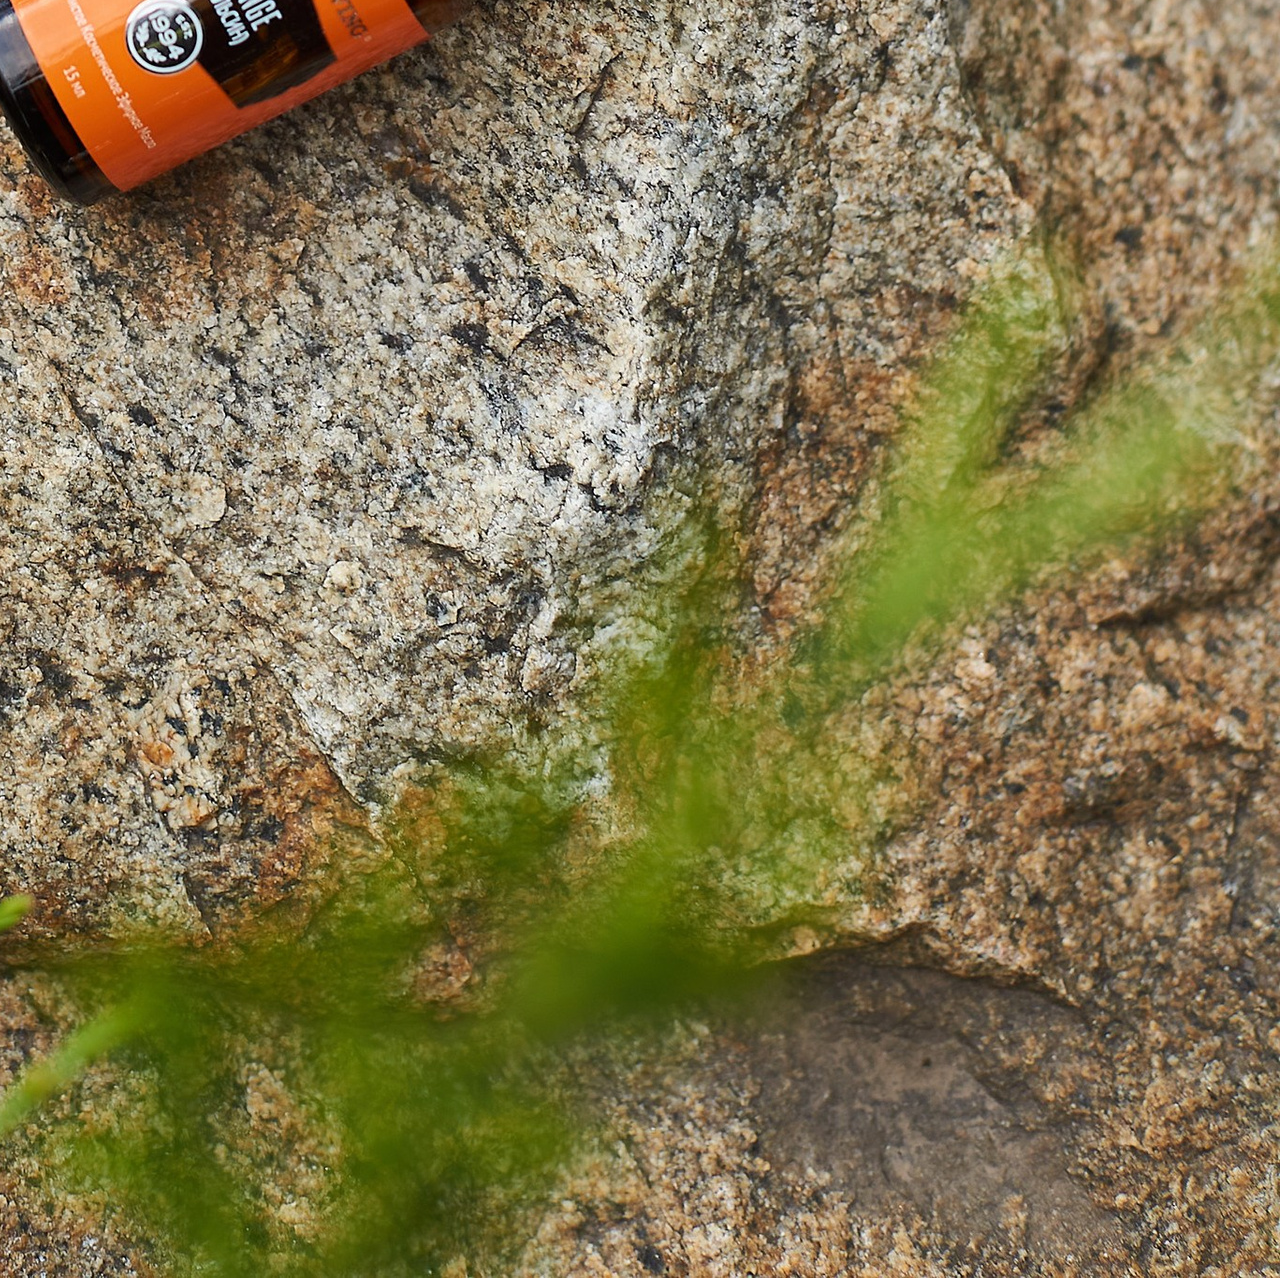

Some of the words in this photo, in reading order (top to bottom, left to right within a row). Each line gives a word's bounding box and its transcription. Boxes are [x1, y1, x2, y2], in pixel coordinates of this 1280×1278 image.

[148, 10, 185, 60] 1994
[63, 65, 79, 82] 15
[71, 80, 87, 99] мл
[80, 24, 123, 96] Косметическое
[115, 91, 144, 130] Эфирное
